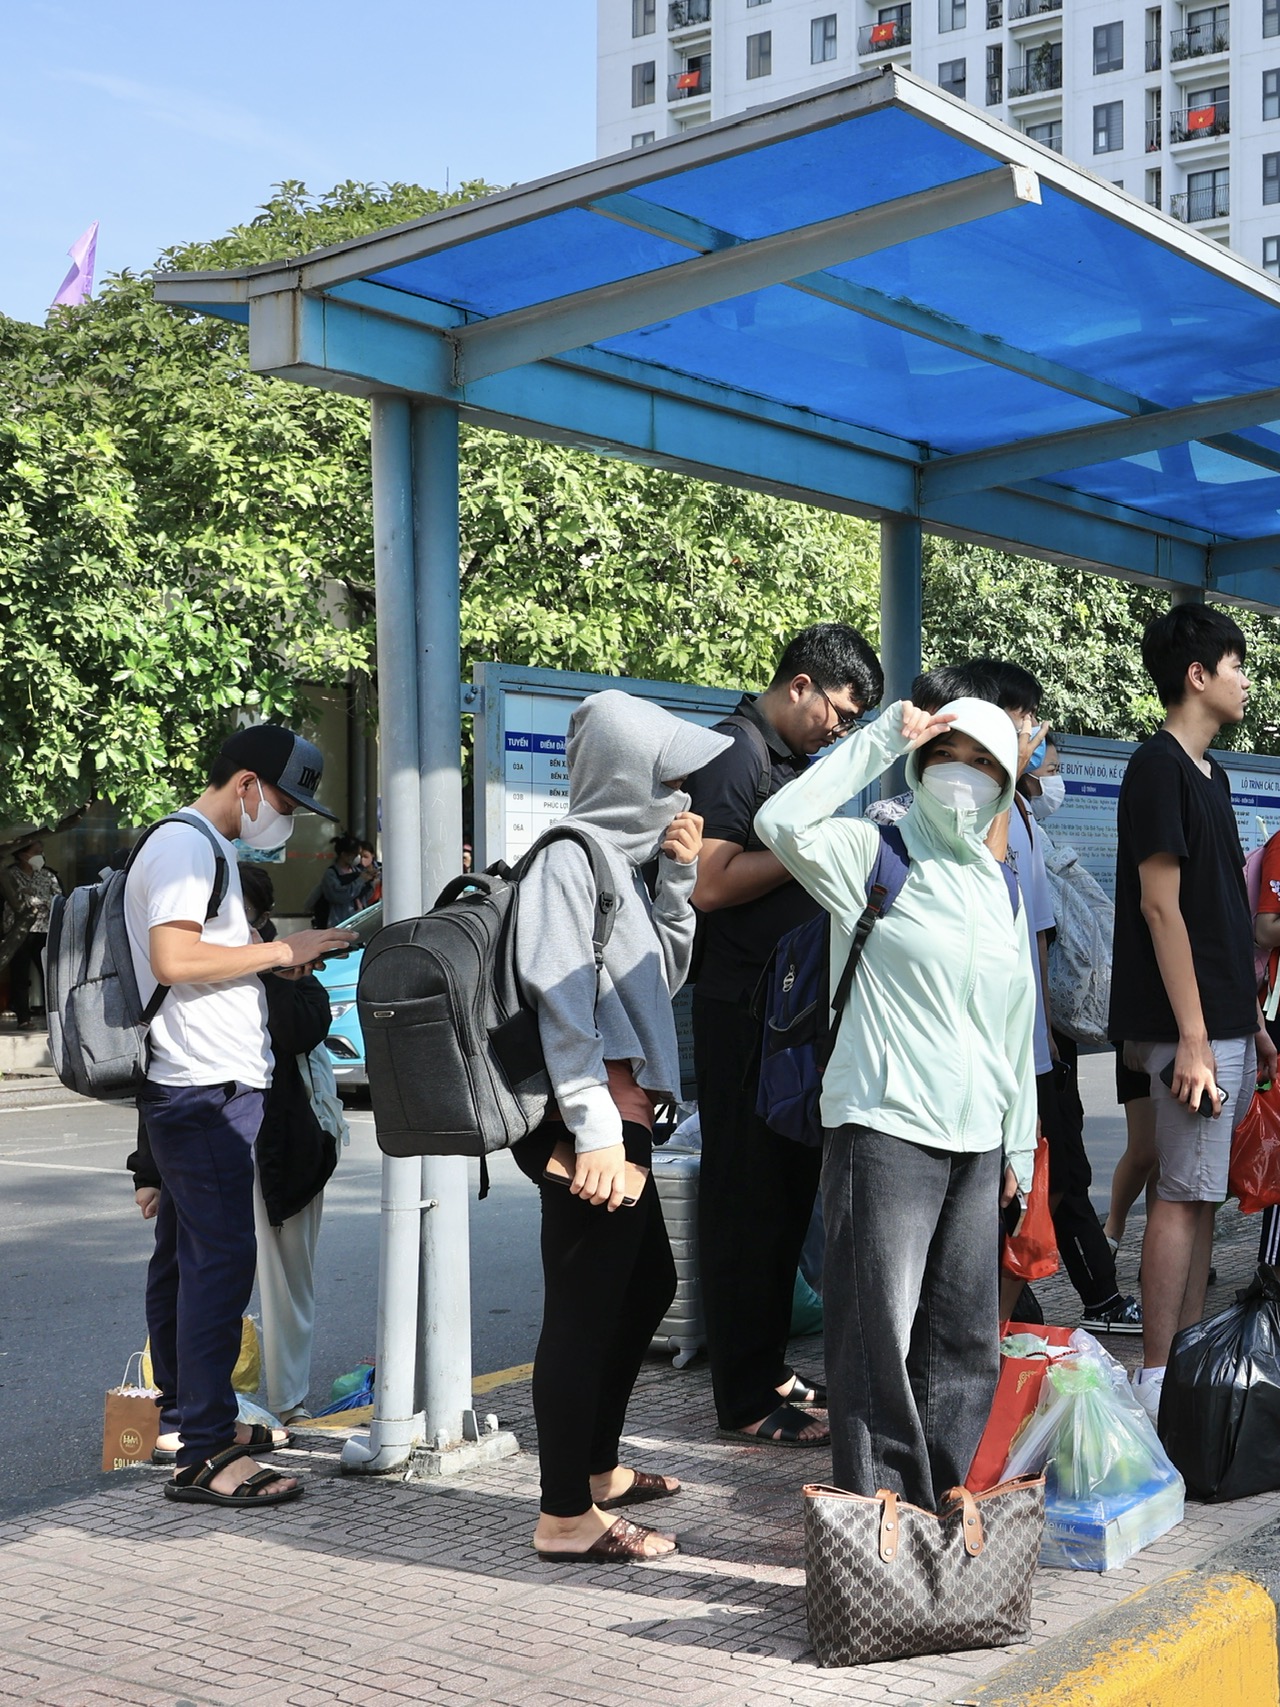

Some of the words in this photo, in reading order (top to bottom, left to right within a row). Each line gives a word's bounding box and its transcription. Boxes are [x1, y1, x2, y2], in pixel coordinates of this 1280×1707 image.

[508, 737, 528, 747] TUYẾN
[540, 740, 555, 750] ĐIỂM
[556, 740, 567, 751] ĐẦ
[513, 763, 524, 771] 03A
[550, 758, 560, 768] BẾN
[1066, 761, 1083, 776] BUÝT
[1084, 762, 1096, 779] NỘI
[551, 772, 561, 780] BẾN
[1241, 777, 1249, 790] LỘ
[1249, 777, 1264, 790] TRÌNH
[1264, 780, 1274, 791] CÁC
[513, 793, 524, 801] 03B
[549, 788, 560, 797] BẾN
[543, 801, 558, 809] PHÚC
[512, 823, 524, 832] 06A
